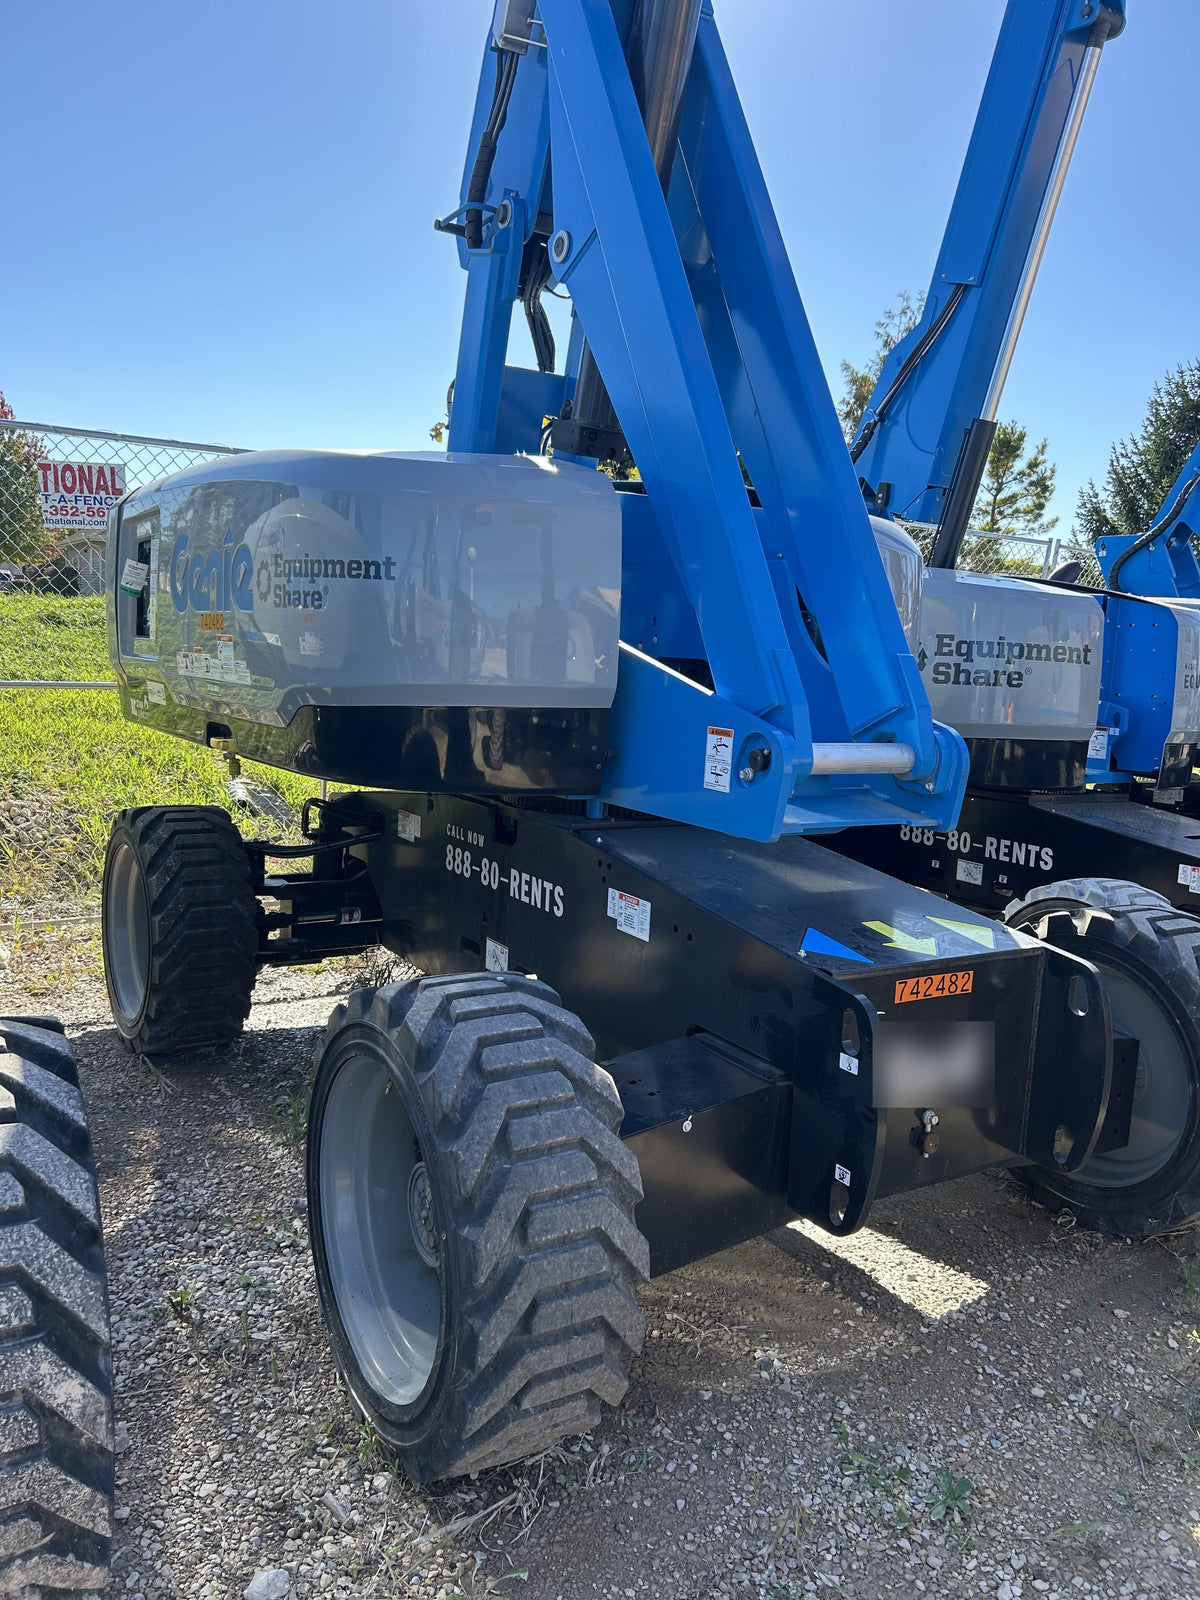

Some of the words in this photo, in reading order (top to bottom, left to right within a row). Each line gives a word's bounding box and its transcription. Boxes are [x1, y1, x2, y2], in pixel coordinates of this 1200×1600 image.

[38, 463, 123, 496] TIONAL
[43, 505, 109, 518] -352-56
[172, 528, 253, 614] Genie
[273, 553, 396, 583] Equipment
[201, 615, 224, 630] 742482
[935, 634, 1091, 664] Equipment
[446, 823, 464, 841] CALL
[467, 829, 485, 848] NOW
[445, 844, 564, 918] 888-80-RENTS
[898, 972, 971, 1002] 742482
